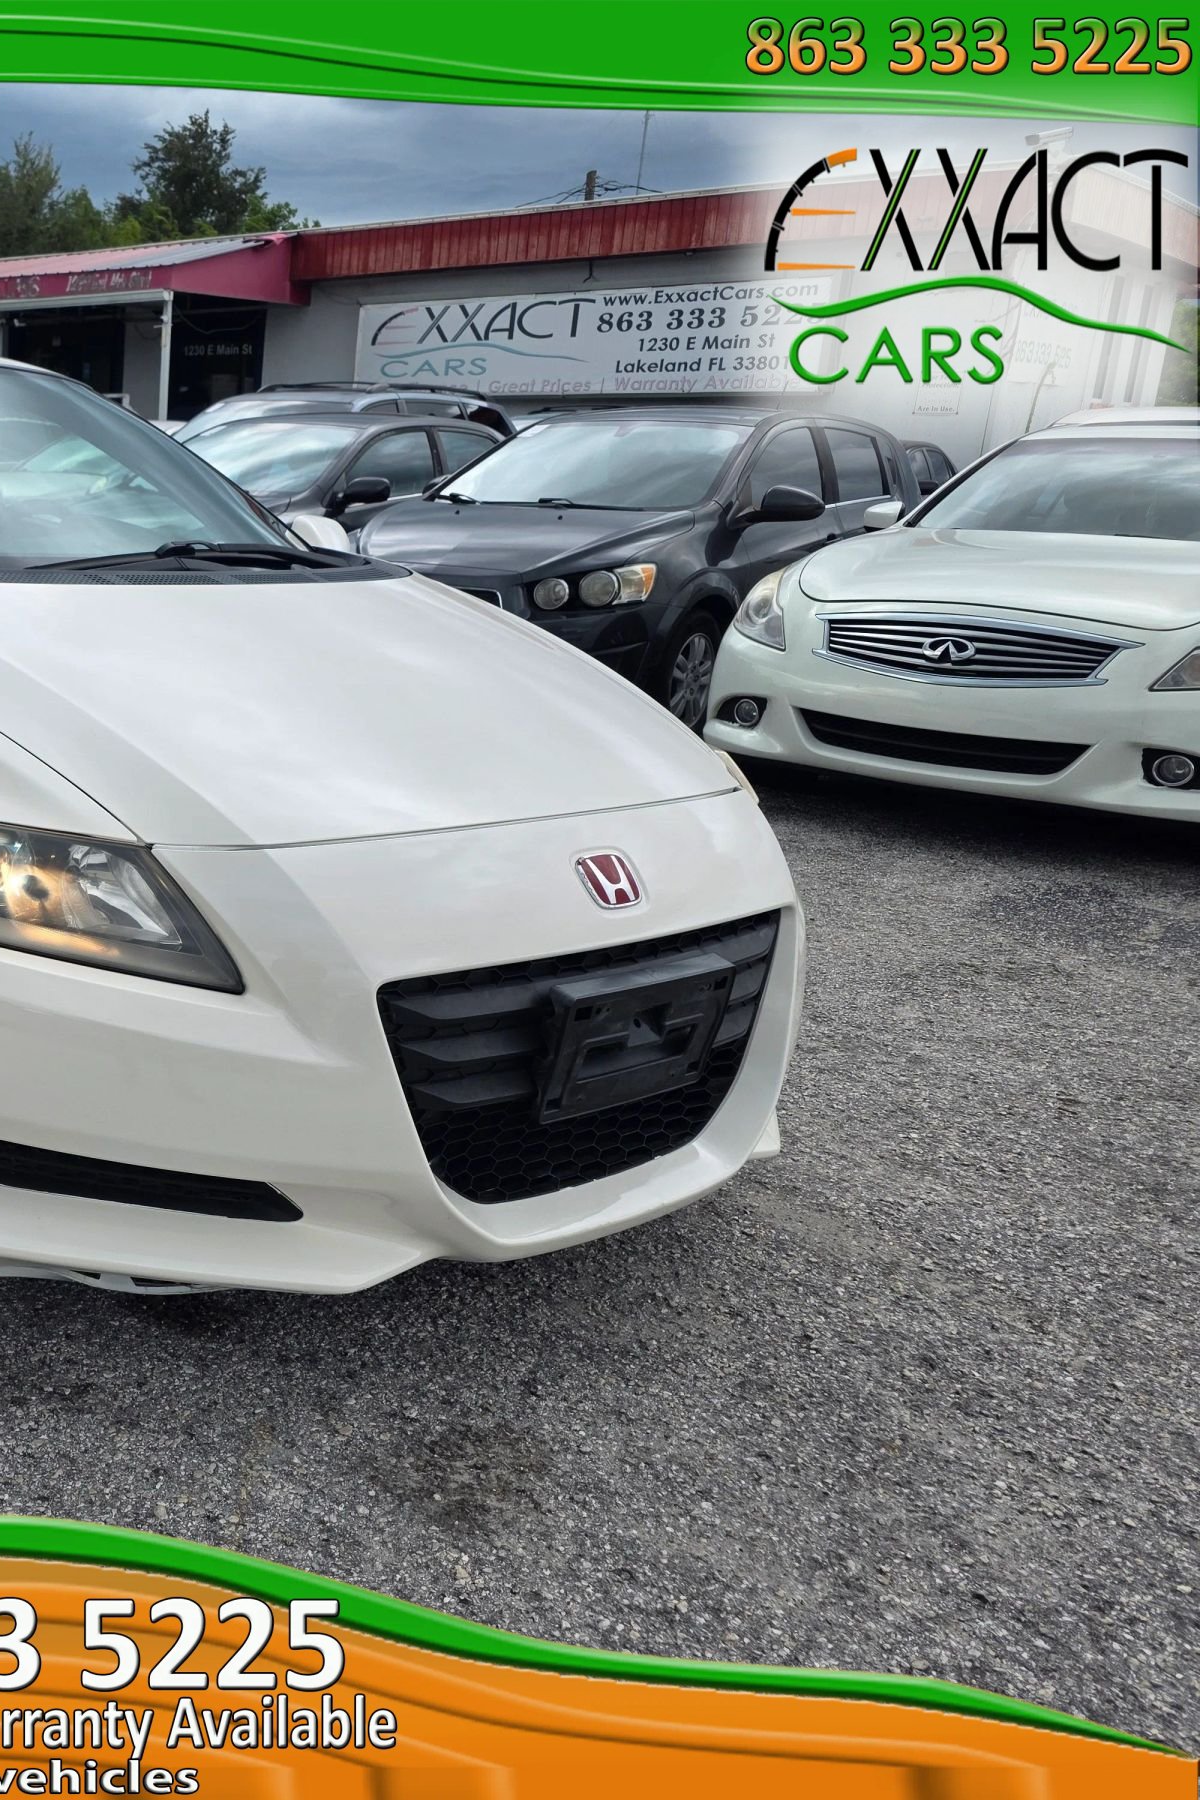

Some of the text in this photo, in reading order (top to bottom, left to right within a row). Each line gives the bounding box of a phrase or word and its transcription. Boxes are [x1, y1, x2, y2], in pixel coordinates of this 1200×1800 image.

[603, 284, 818, 307] www.ExxactCars.com
[371, 297, 596, 346] EXXACT
[597, 310, 653, 333] 863
[666, 307, 726, 330] 333
[184, 343, 253, 356] 1230 E Main St
[639, 333, 775, 352] 1230 E Main St
[380, 357, 487, 378] CARS
[615, 355, 789, 374] Lakeland FL 33801
[489, 372, 800, 394] Great Prices Warranty Available
